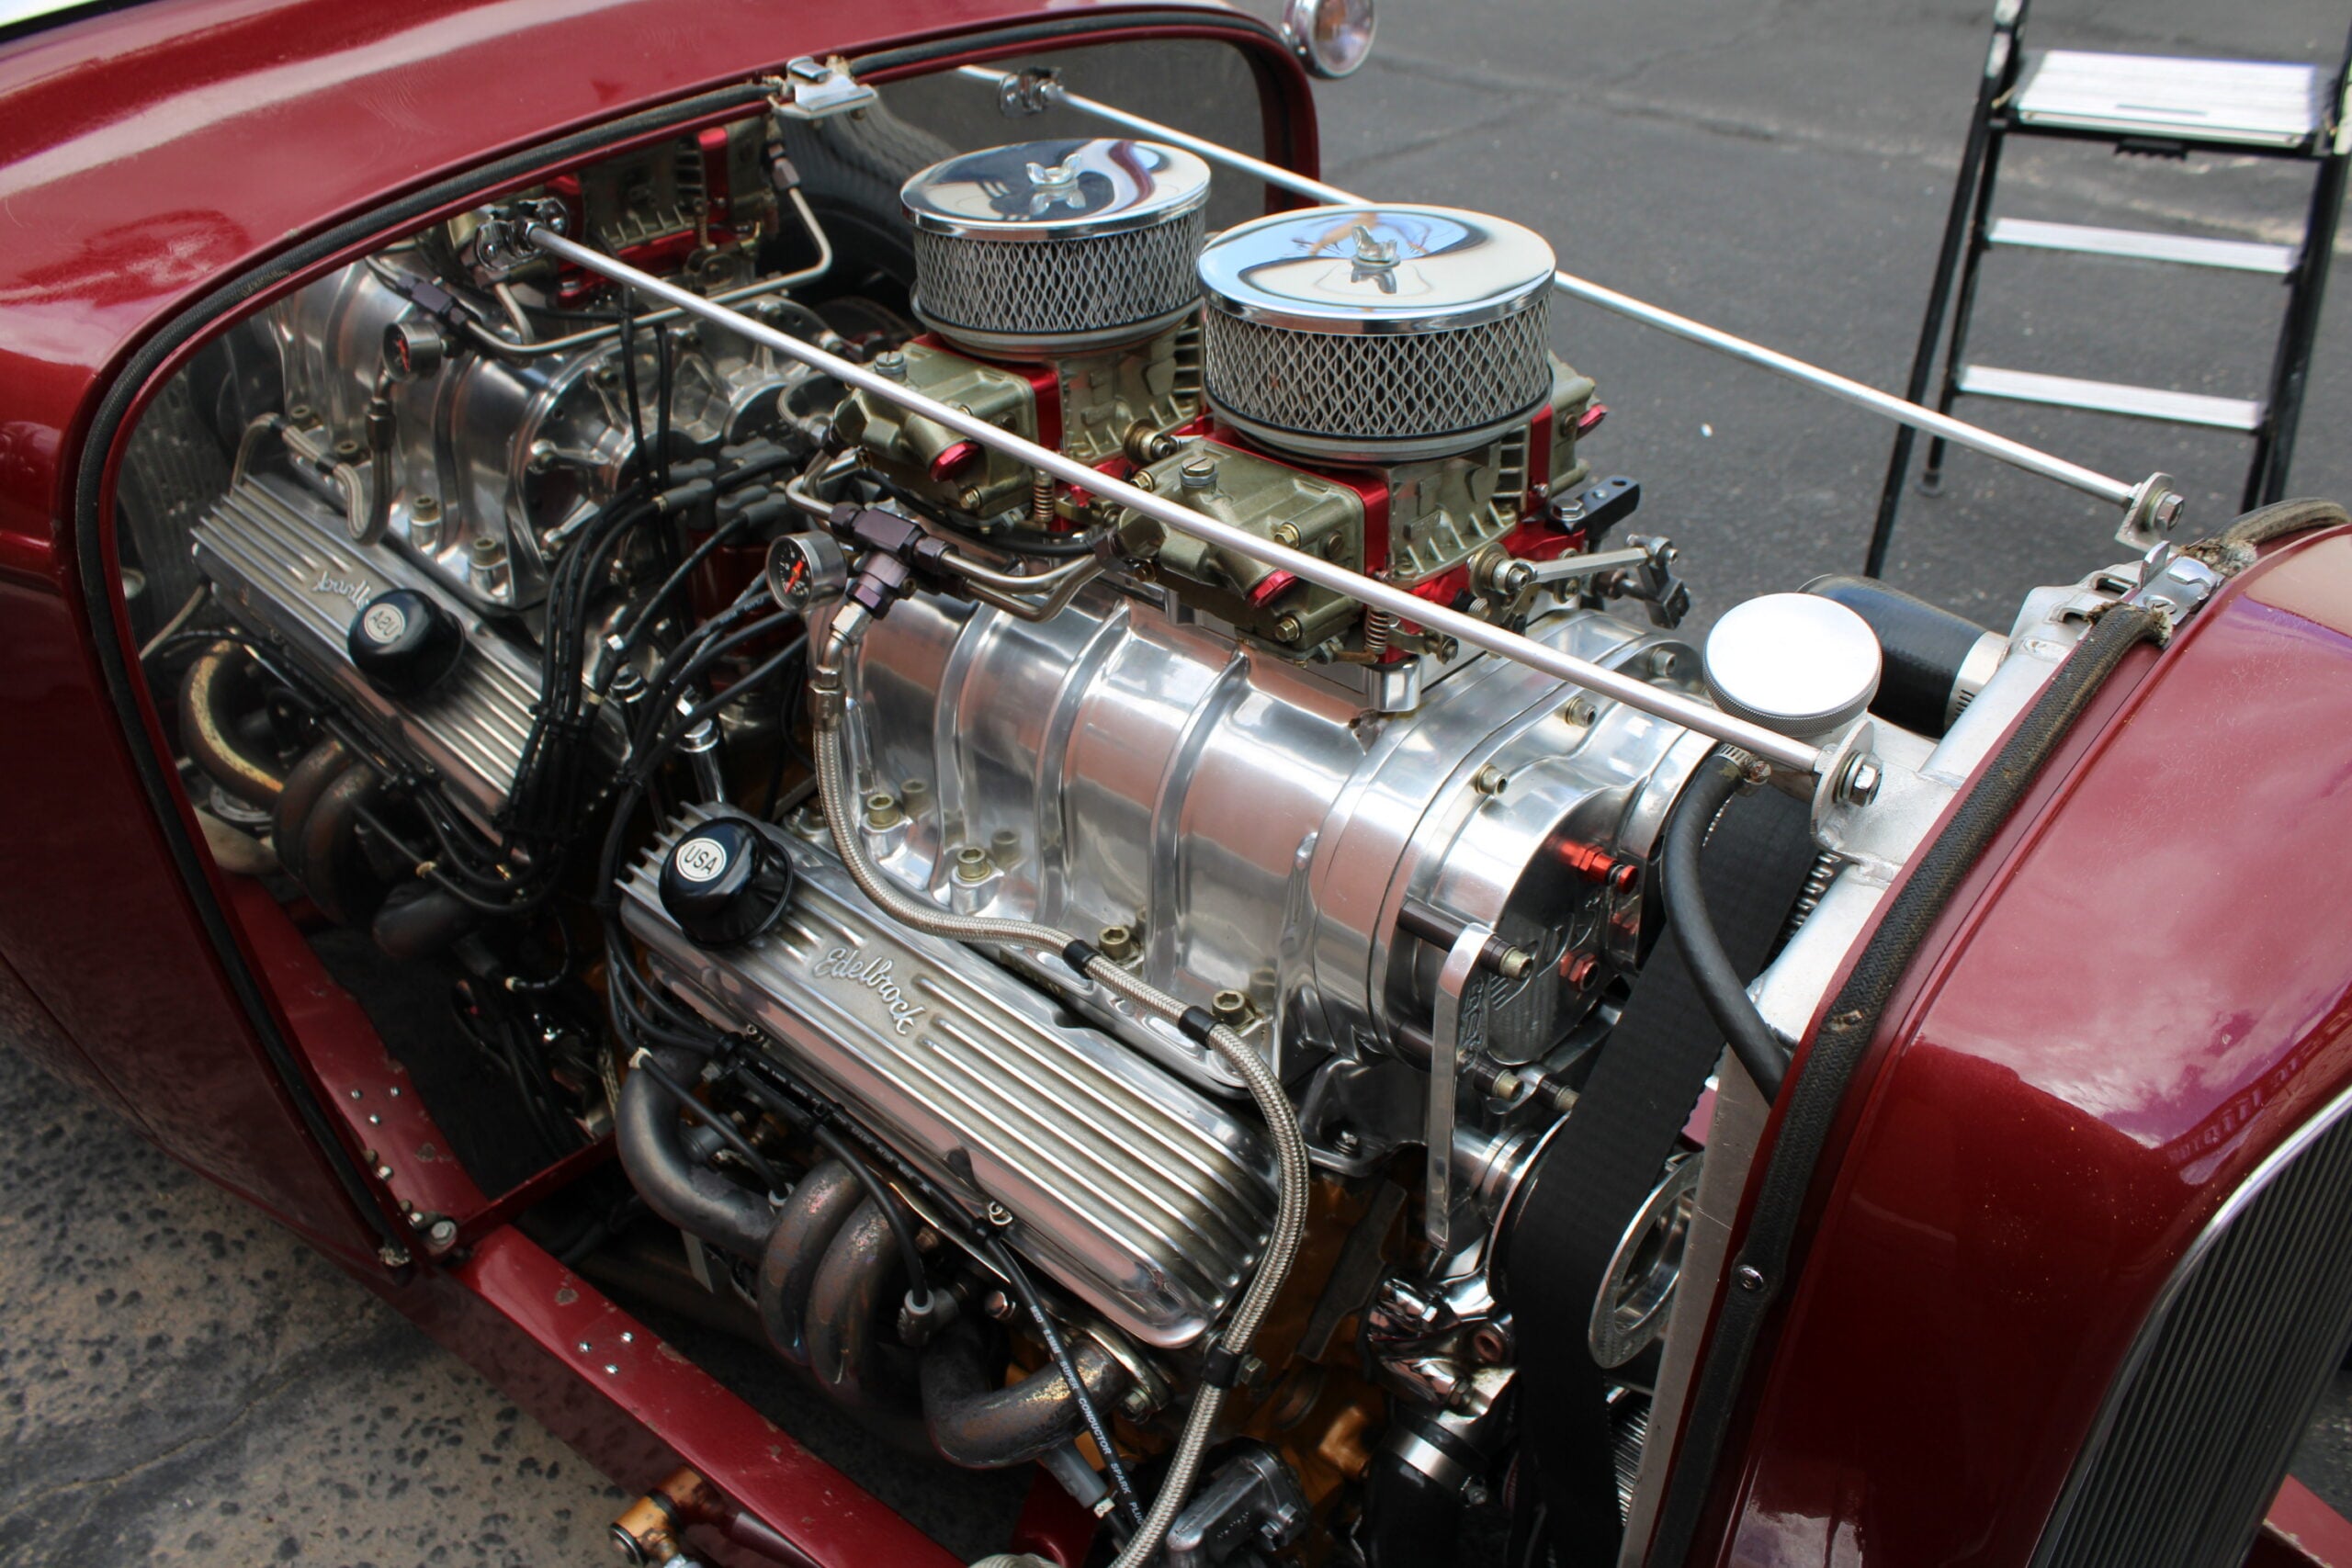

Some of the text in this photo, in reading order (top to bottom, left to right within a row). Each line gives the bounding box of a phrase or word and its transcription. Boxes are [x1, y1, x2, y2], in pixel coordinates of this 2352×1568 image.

[684, 845, 718, 875] USA
[813, 947, 926, 1036] Edelbrock
[1059, 1360, 1080, 1391] SUPER
[1078, 1397, 1113, 1456] CONDUCTOR
[1110, 1462, 1133, 1495] SPARK
